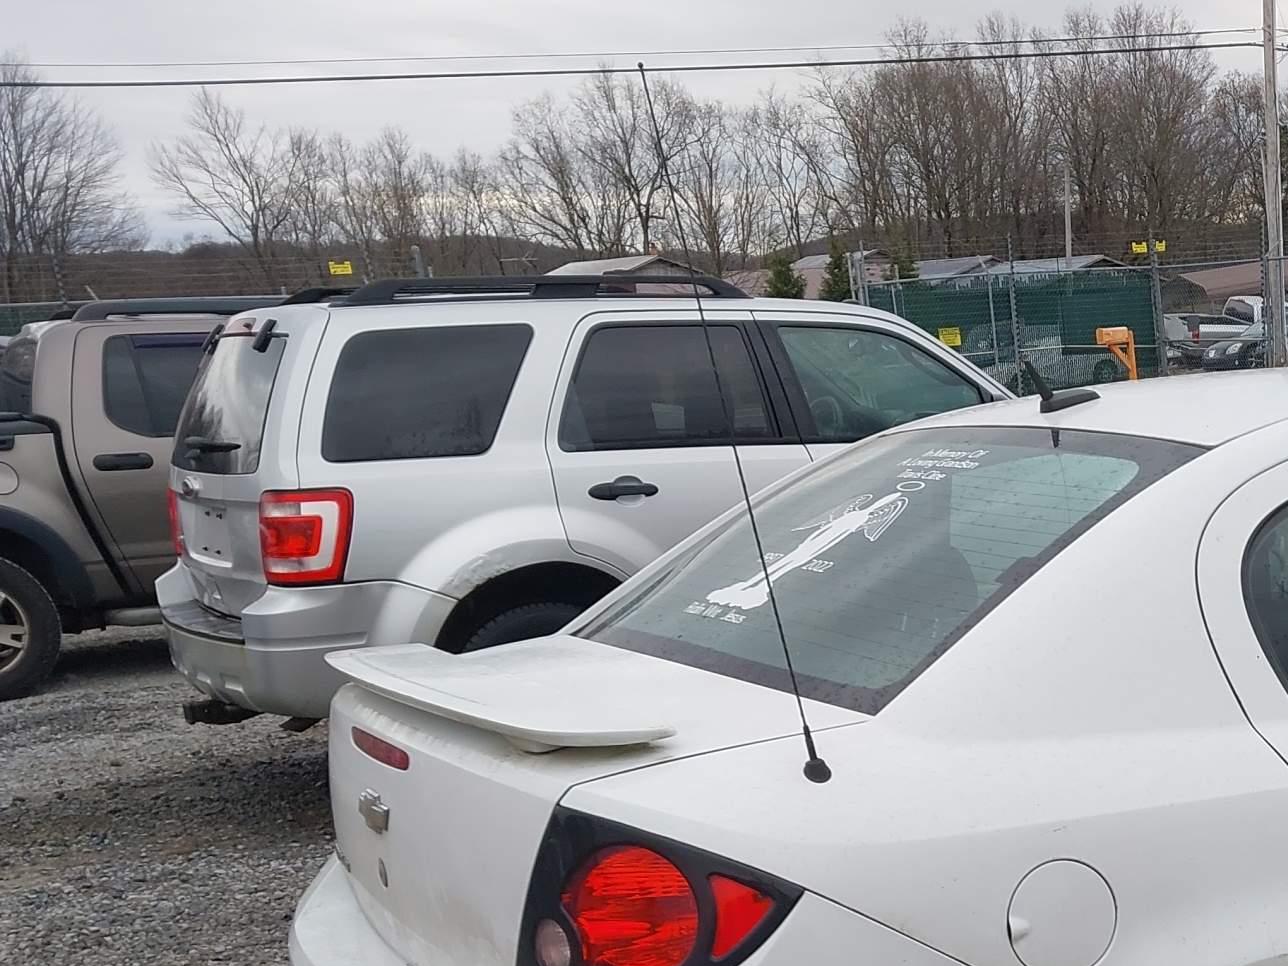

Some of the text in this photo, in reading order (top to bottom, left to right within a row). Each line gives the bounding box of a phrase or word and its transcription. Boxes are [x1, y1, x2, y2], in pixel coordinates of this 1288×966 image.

[933, 449, 970, 460] Memory
[908, 458, 939, 469] Loving
[935, 459, 980, 469] Grandson
[801, 559, 834, 573] 2022
[720, 609, 748, 624] Jesus
